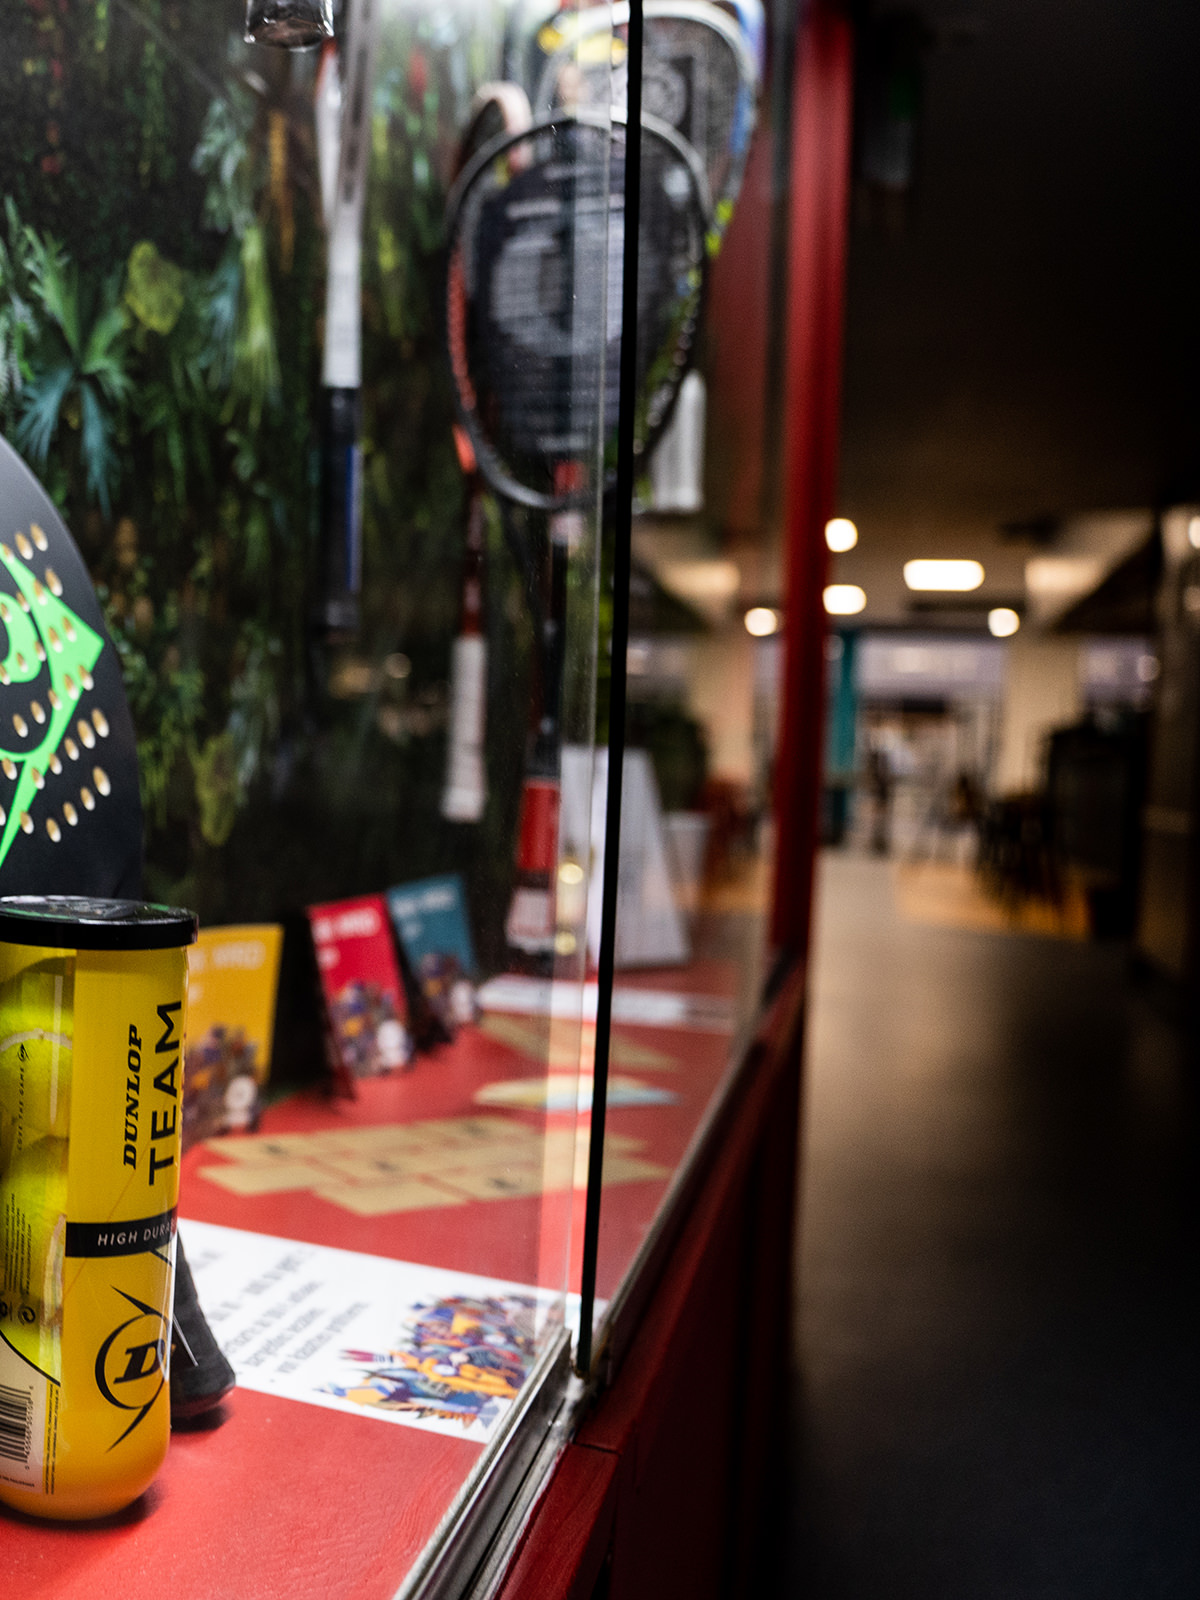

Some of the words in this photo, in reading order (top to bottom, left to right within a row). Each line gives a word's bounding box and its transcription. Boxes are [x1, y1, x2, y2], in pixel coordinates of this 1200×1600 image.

[123, 1023, 142, 1170] DUNLOP
[148, 1000, 182, 1186] TEAM
[97, 1230, 138, 1247] HIGH
[113, 1337, 165, 1384] D
